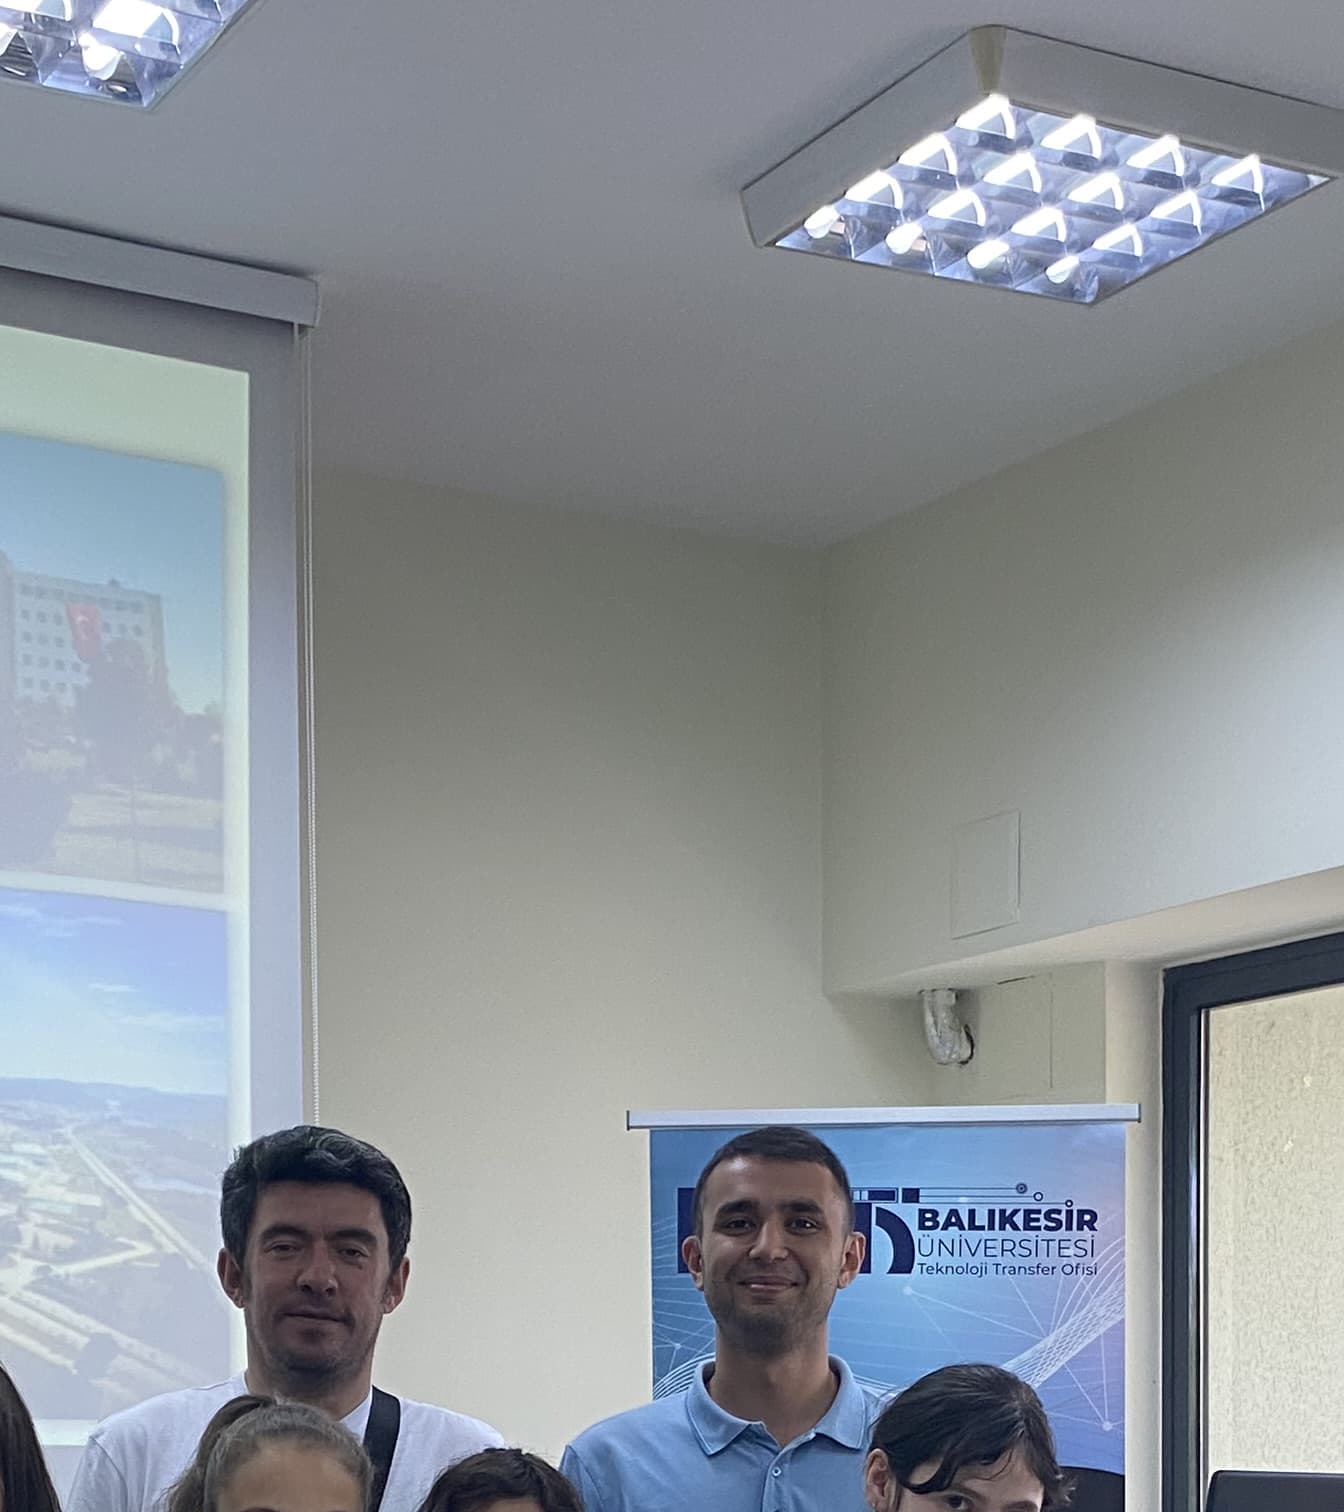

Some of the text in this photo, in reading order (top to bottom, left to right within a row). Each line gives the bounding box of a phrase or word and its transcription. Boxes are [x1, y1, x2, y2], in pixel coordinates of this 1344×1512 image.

[918, 1203, 1098, 1232] BALIKESİR
[918, 1234, 1096, 1258] ÜNİVERSİTESİ
[917, 1262, 1098, 1278] Teknoloji Transfer Ofisi
